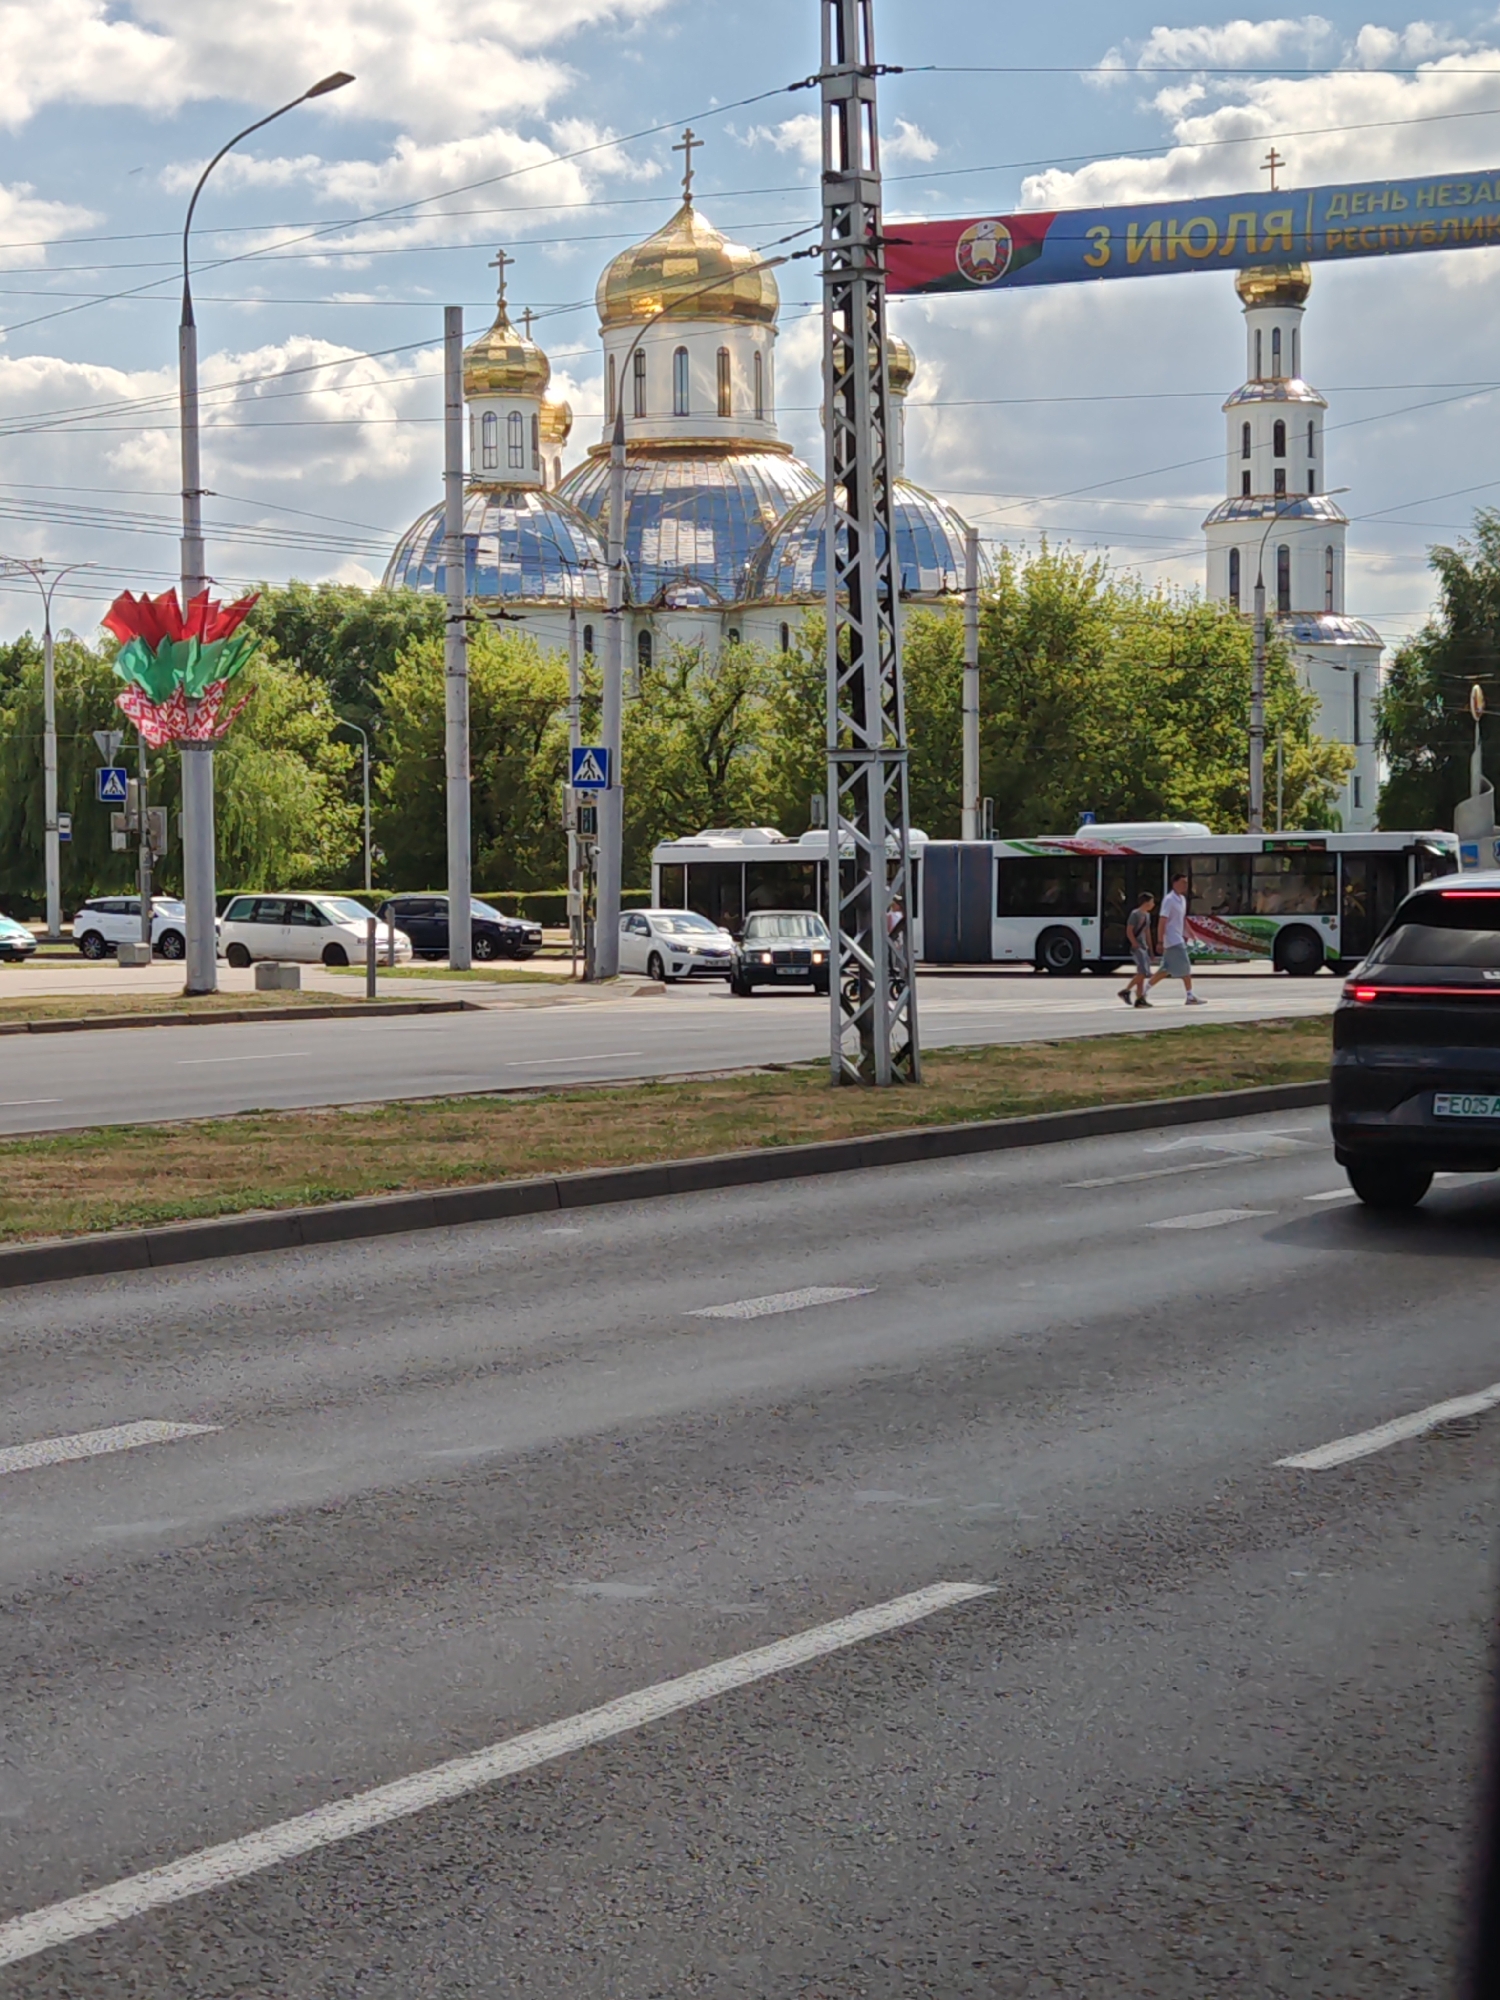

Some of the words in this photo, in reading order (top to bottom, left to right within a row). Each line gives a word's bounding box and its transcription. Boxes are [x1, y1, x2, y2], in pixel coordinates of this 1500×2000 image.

[1325, 190, 1409, 222] ДЕНЬ
[1083, 225, 1111, 267] 3
[1126, 209, 1293, 264] ИЮЛЯ
